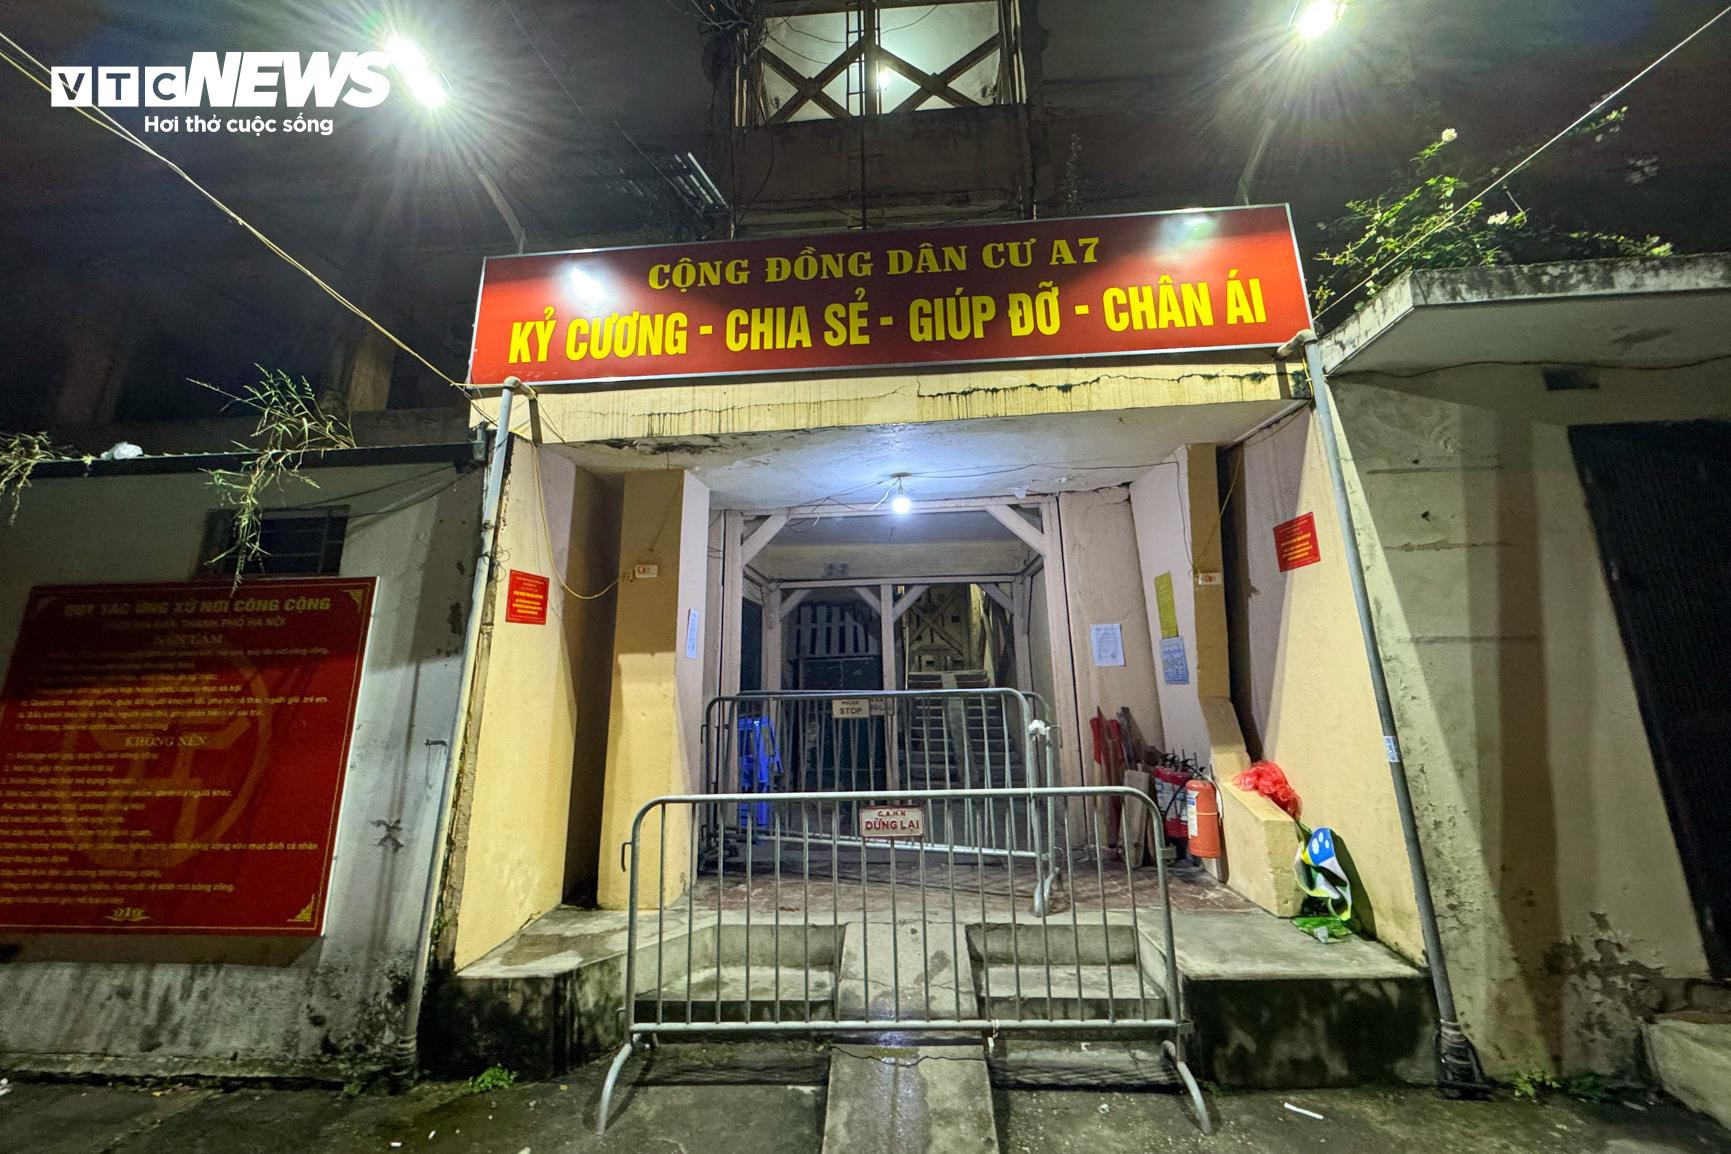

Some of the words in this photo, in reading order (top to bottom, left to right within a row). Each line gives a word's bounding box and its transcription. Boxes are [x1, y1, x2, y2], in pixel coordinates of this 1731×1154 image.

[647, 257, 749, 292] CỘNG
[766, 246, 873, 288] ĐỒNG
[887, 245, 967, 275] DÂN
[982, 238, 1037, 269] CƯ
[1050, 236, 1100, 266] A7
[508, 306, 557, 364] KỶ
[565, 310, 689, 361] CƯƠNG
[725, 306, 813, 352] CHIA
[823, 287, 871, 346] SẺ
[909, 287, 997, 343] GIÚP
[1007, 281, 1061, 337] ĐỠ
[1103, 274, 1214, 332] CHÂN
[1226, 268, 1267, 325] ÁI
[839, 707, 862, 715] STOP
